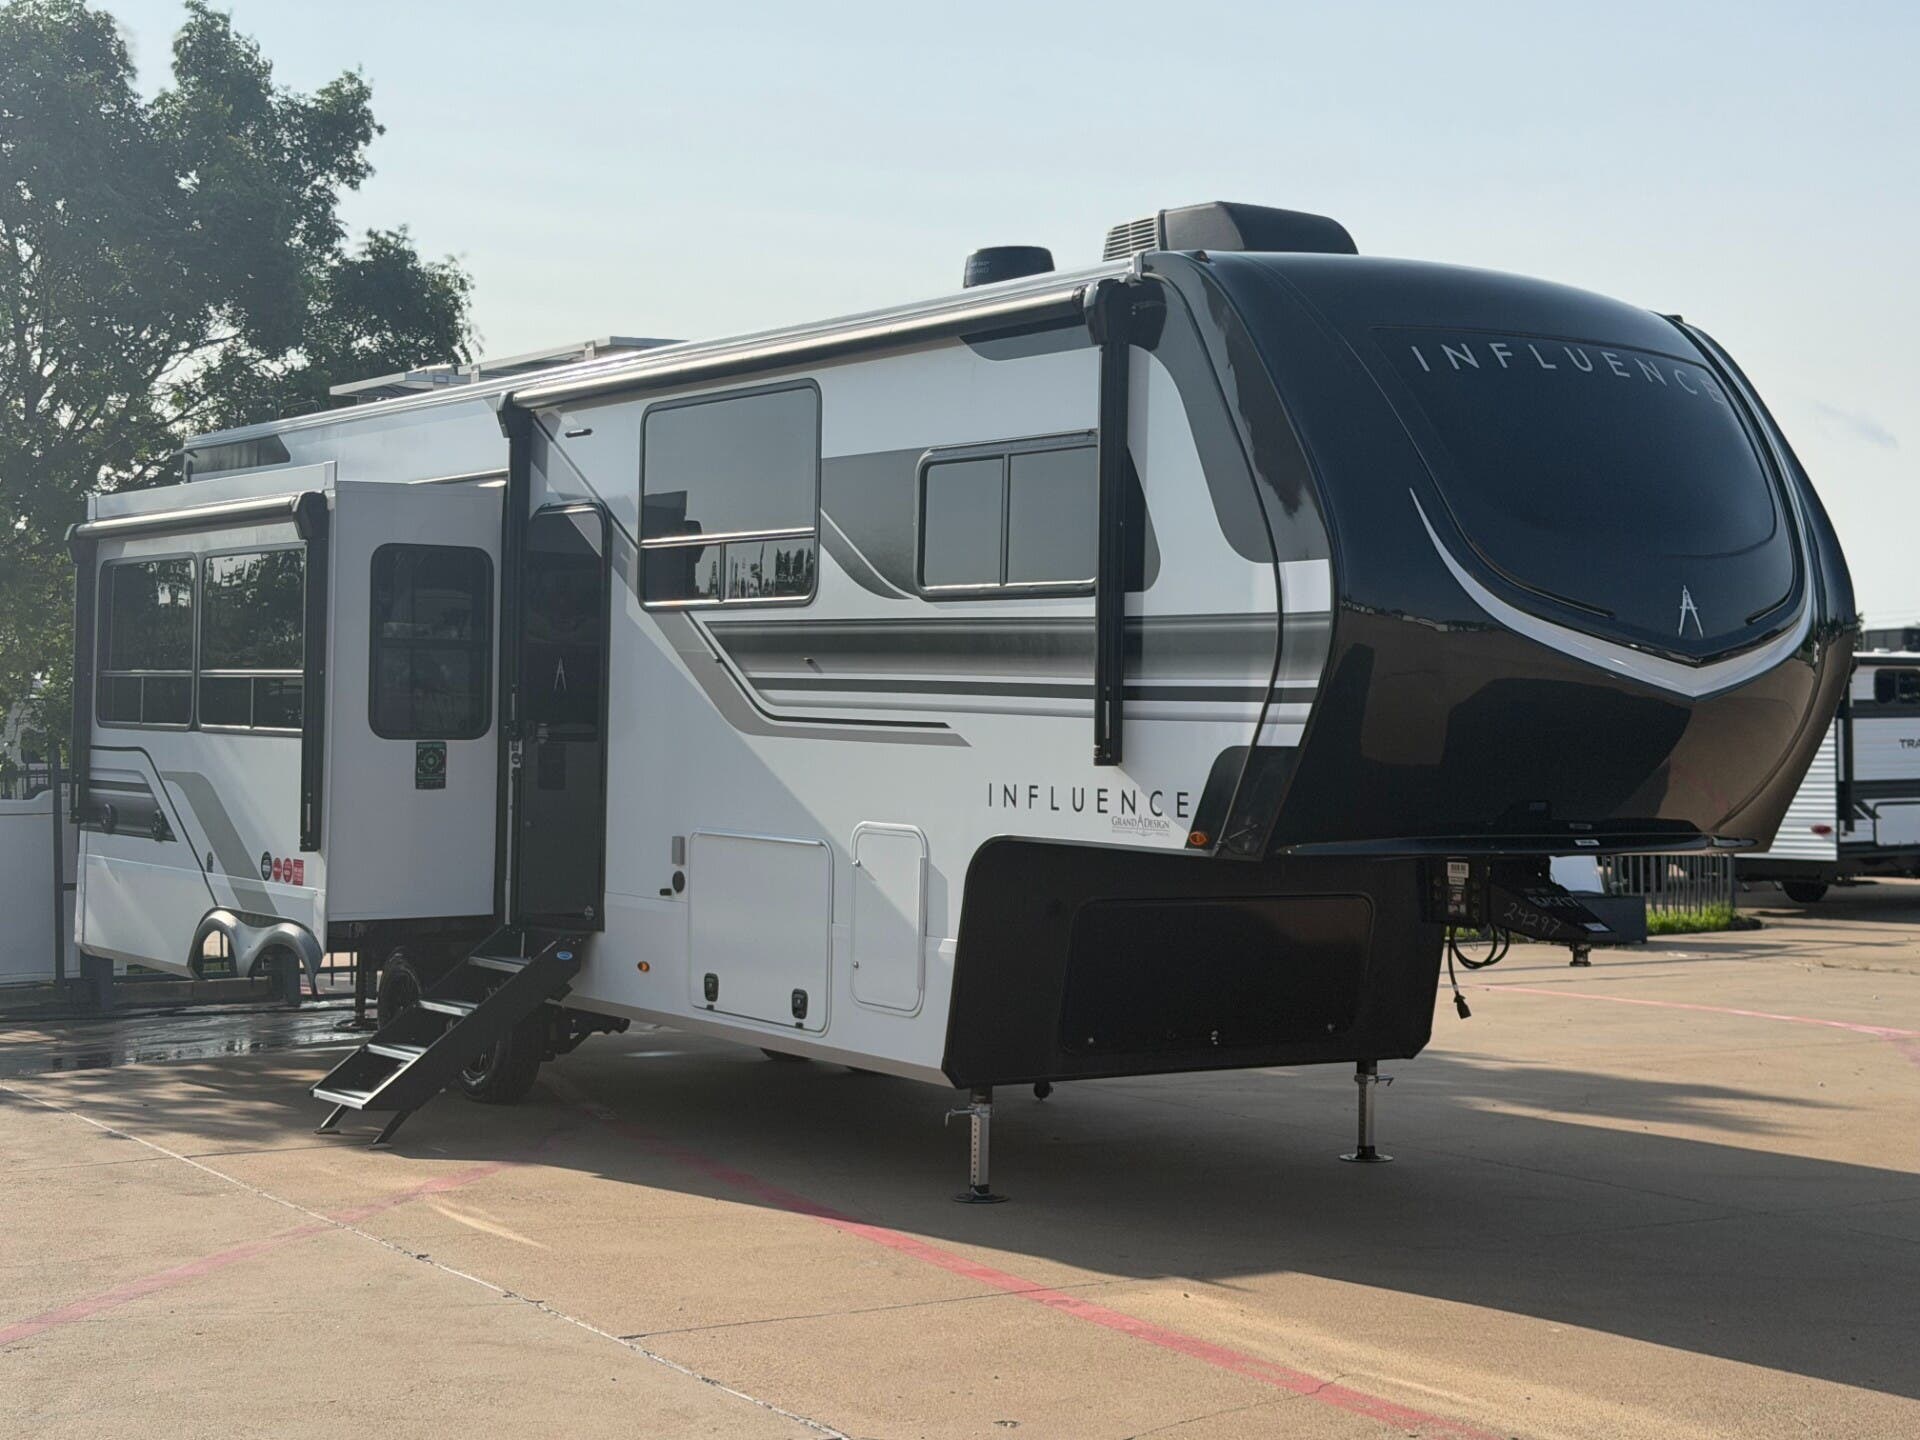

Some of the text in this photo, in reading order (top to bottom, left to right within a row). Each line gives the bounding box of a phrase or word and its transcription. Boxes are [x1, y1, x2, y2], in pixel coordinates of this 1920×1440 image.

[1411, 343, 1724, 404] INFLUENCE
[988, 782, 1189, 818] INFLUENCE
[1111, 815, 1170, 829] GRAND DESIGN
